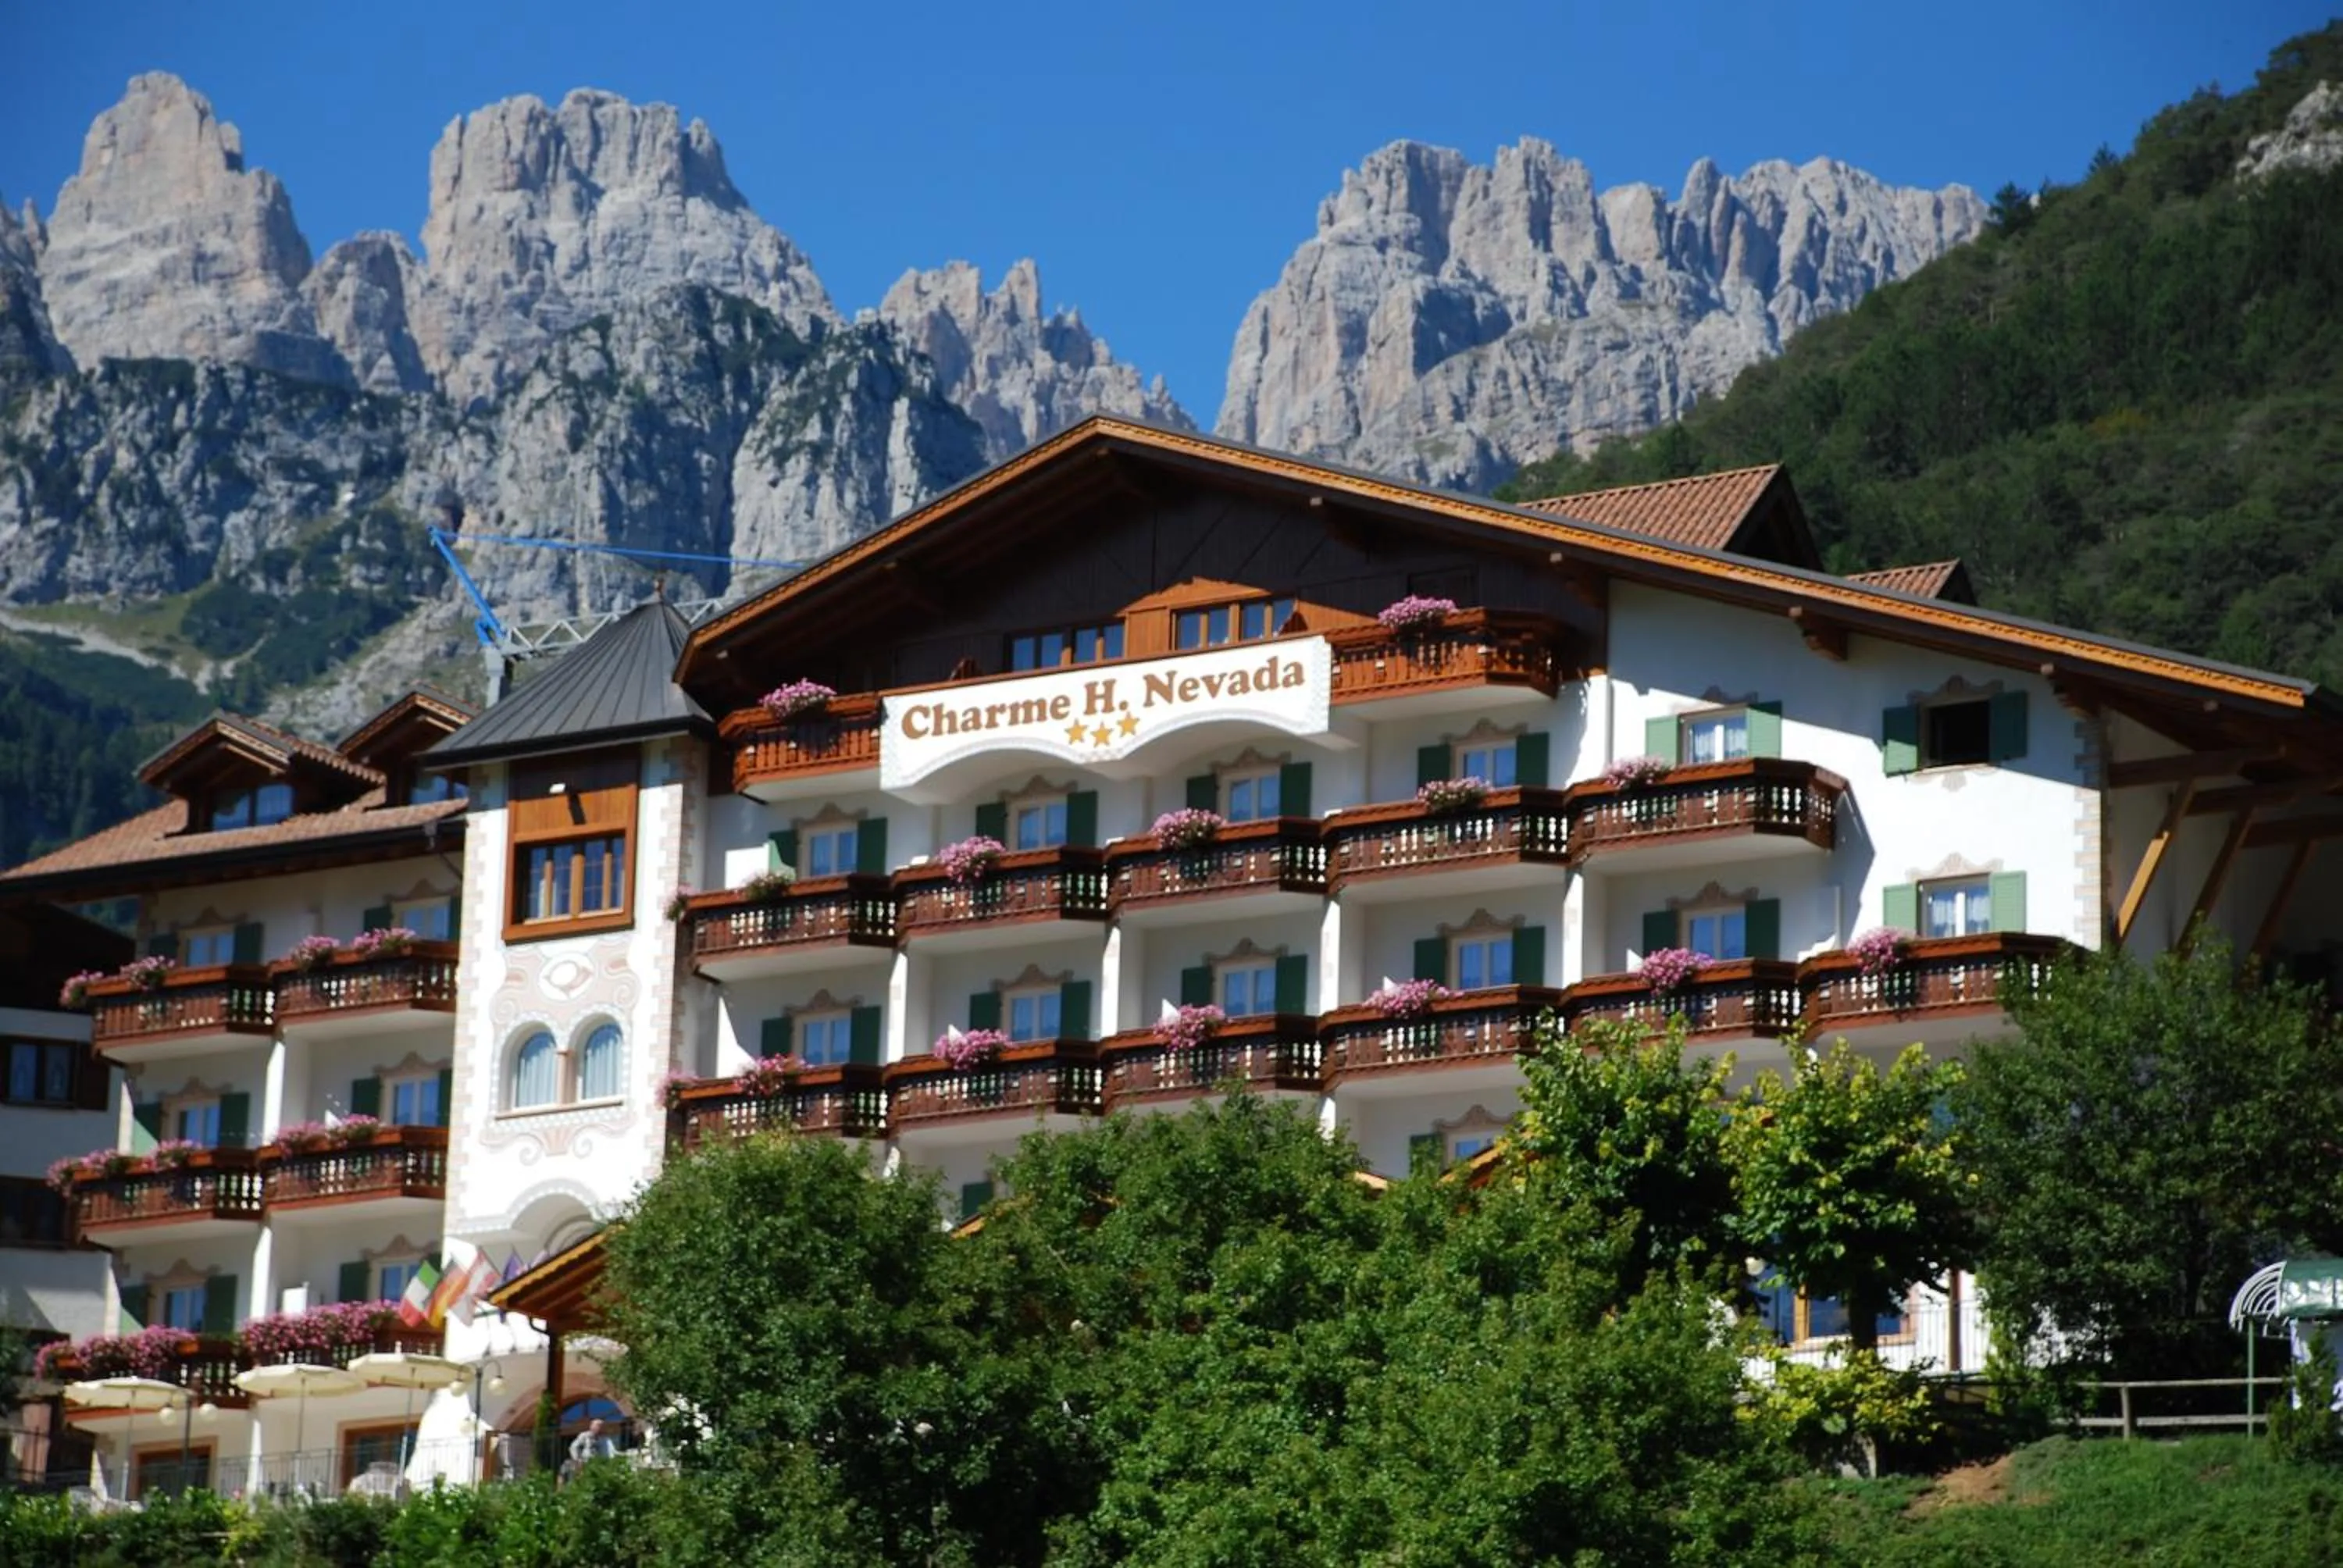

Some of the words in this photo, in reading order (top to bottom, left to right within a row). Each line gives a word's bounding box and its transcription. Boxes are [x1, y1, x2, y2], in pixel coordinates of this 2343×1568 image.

[901, 694, 1071, 739] Charme
[1084, 679, 1129, 715] H.
[1143, 655, 1304, 707] Nevada
